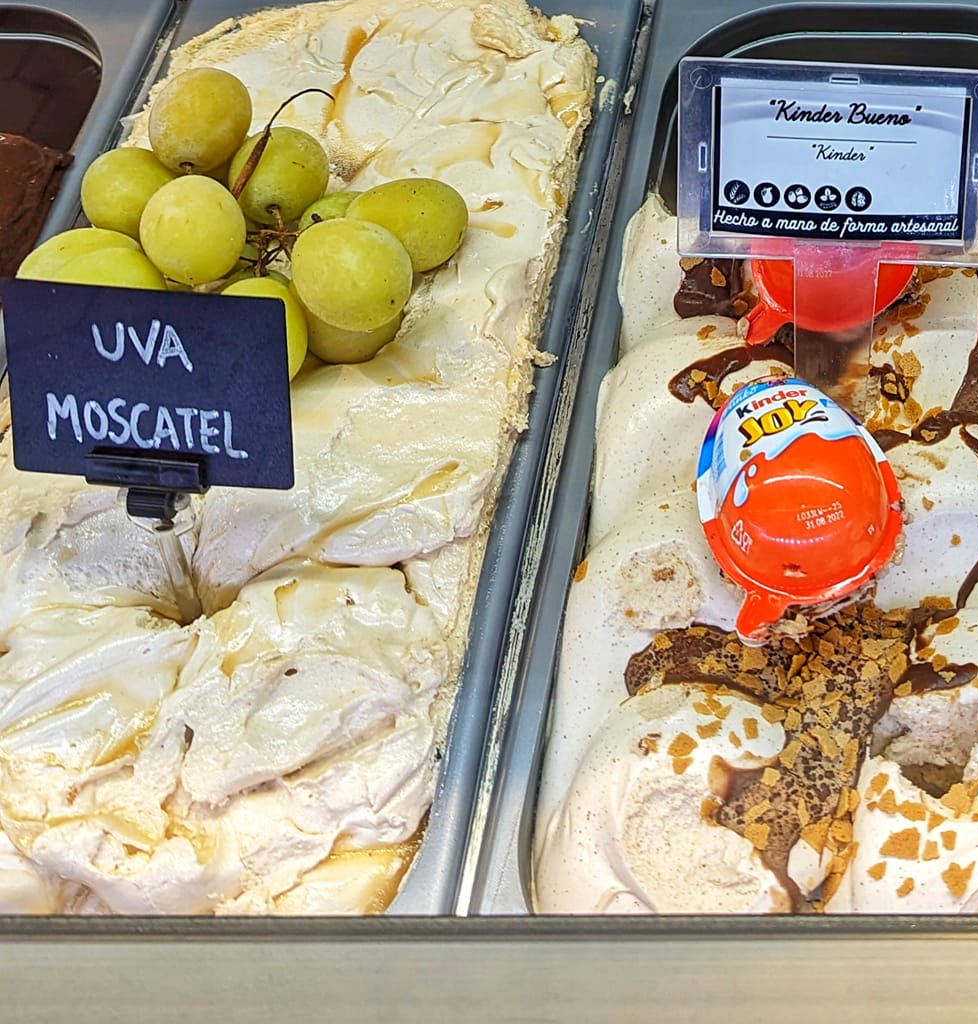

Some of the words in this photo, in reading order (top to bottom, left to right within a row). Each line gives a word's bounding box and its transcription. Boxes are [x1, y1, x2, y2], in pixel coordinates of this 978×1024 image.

[714, 209, 758, 226] Hecho
[762, 218, 773, 227] a
[776, 219, 817, 230] mano
[821, 218, 839, 231] de
[840, 219, 888, 237] forma
[891, 218, 958, 232] artesanal
[92, 319, 193, 373] UVA
[46, 392, 248, 459] MOSCATEL
[738, 399, 818, 448] JOY
